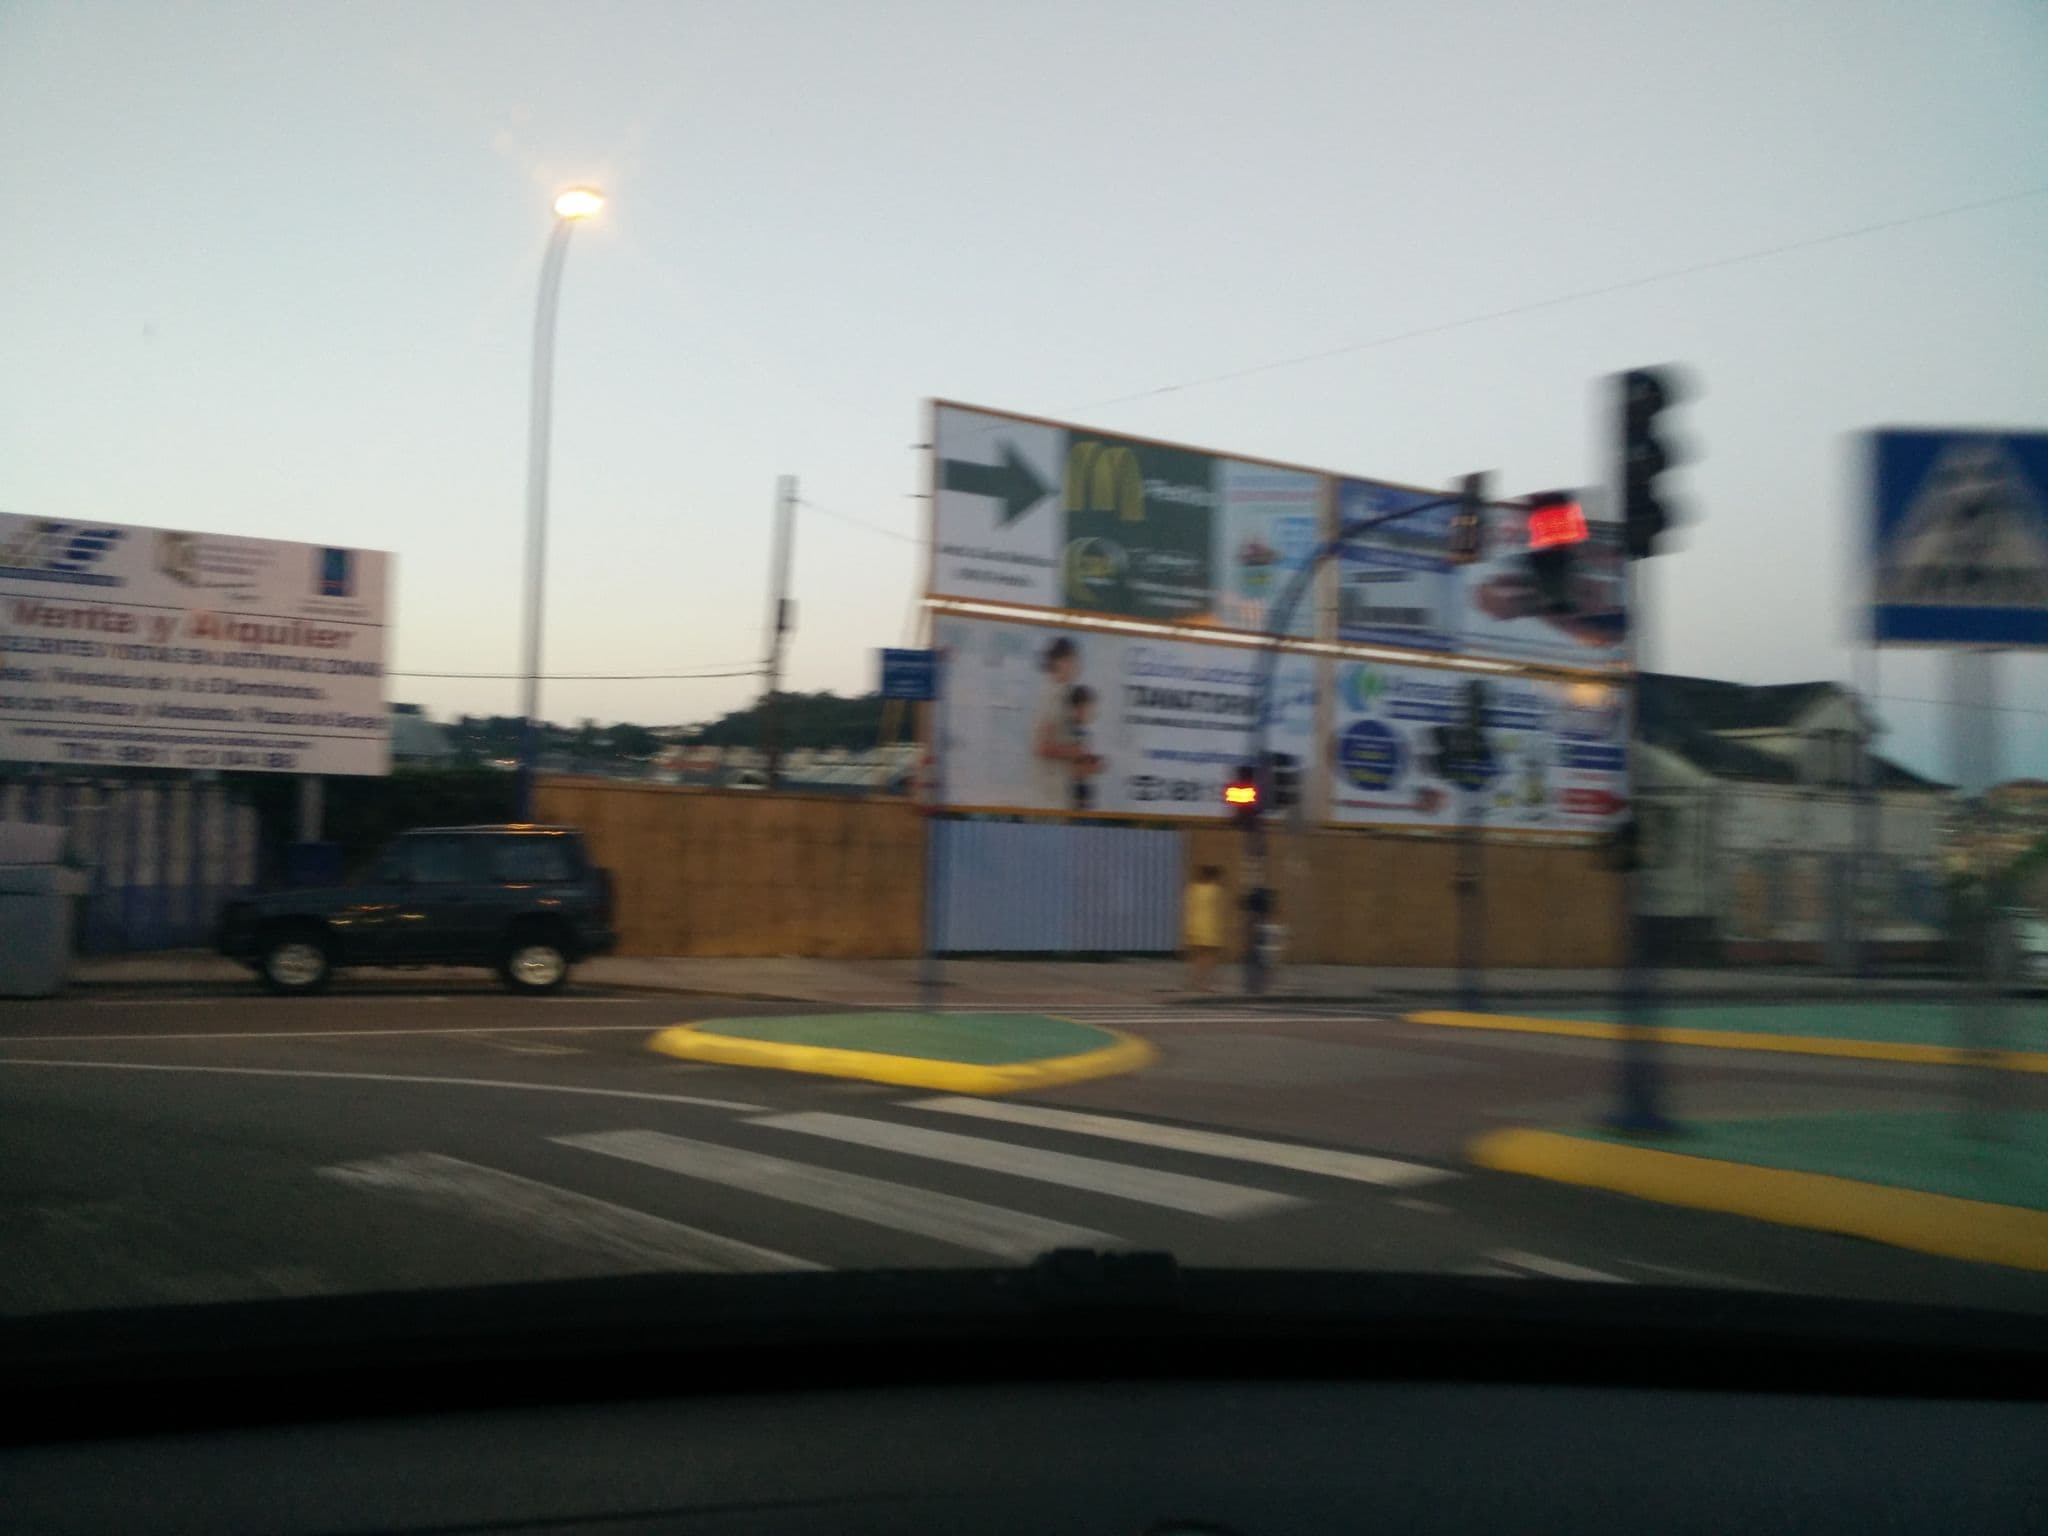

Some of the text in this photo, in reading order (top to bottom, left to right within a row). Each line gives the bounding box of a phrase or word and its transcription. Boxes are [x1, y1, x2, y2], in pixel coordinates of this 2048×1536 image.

[12, 600, 137, 634] Venta
[148, 615, 178, 643] y
[183, 609, 356, 649] Alquiler
